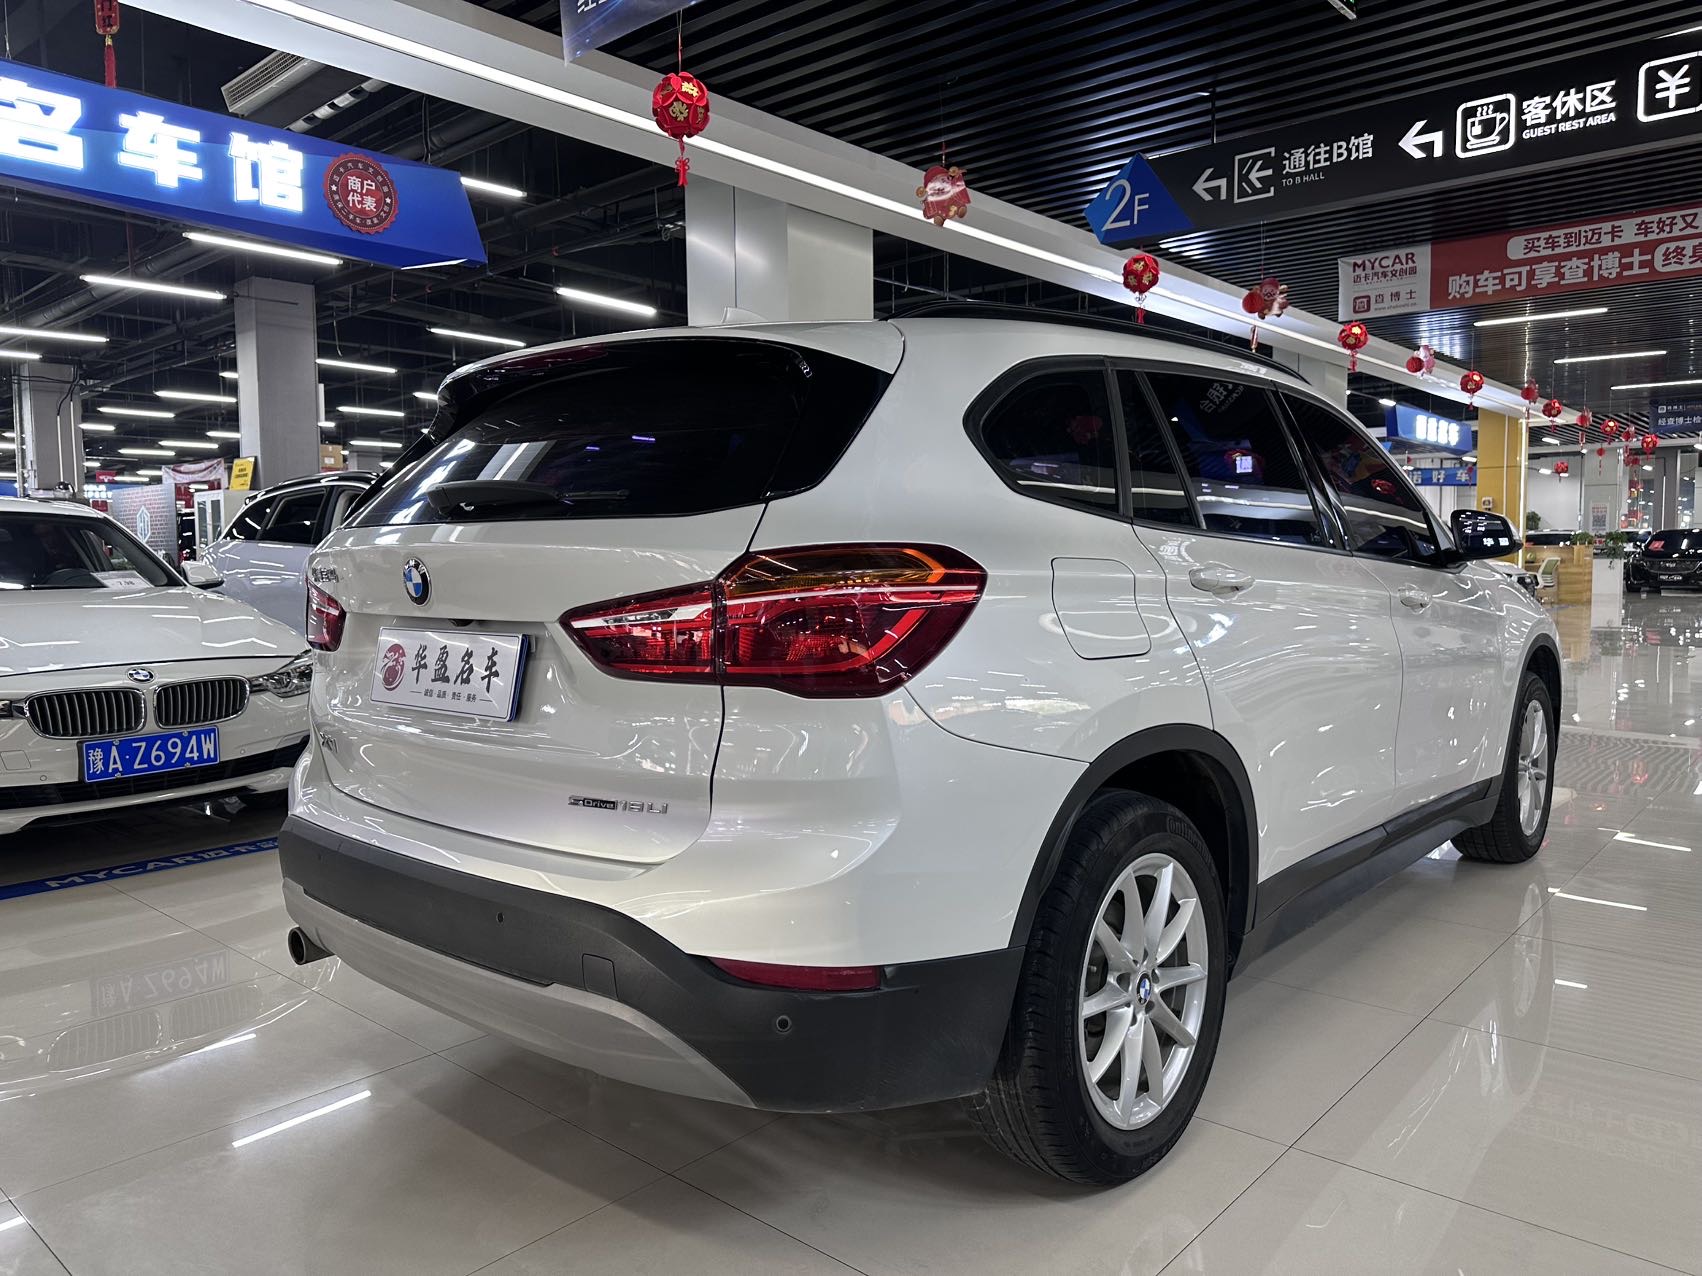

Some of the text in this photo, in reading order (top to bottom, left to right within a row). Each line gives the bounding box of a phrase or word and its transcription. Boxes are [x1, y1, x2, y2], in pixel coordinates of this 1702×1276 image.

[1521, 79, 1616, 126] 客休区
[0, 76, 303, 212] 名车馆
[1522, 112, 1616, 139] GUEST REST AREA
[1282, 133, 1374, 174] 通往B馆
[347, 176, 376, 194] 商户
[1282, 172, 1325, 187] TO B HALL
[347, 192, 377, 211] 代表
[1101, 178, 1149, 231] 2F
[1523, 212, 1700, 256] 买车到迈卡 车好又
[1353, 252, 1416, 273] MYCAR
[1448, 248, 1651, 300] 购车可享查博士
[411, 643, 500, 694] 华盈名车
[46, 853, 201, 888] MYCAR
